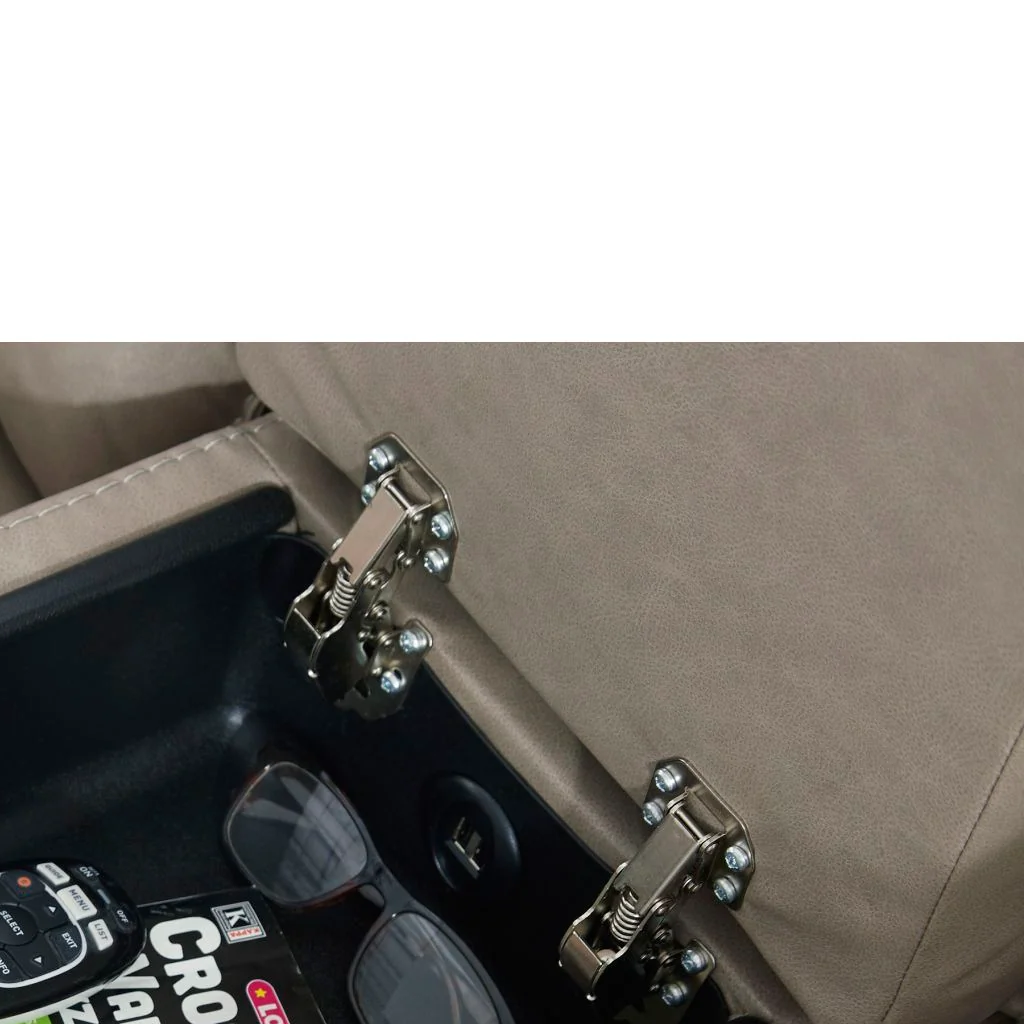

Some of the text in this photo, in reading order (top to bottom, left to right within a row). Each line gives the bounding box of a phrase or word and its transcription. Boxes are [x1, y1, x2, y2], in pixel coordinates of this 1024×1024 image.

[69, 888, 89, 911] MENU
[94, 923, 107, 940] LIST
[79, 866, 93, 878] ON
[115, 908, 129, 924] OFF
[224, 904, 249, 930] K
[61, 931, 78, 949] EXIT
